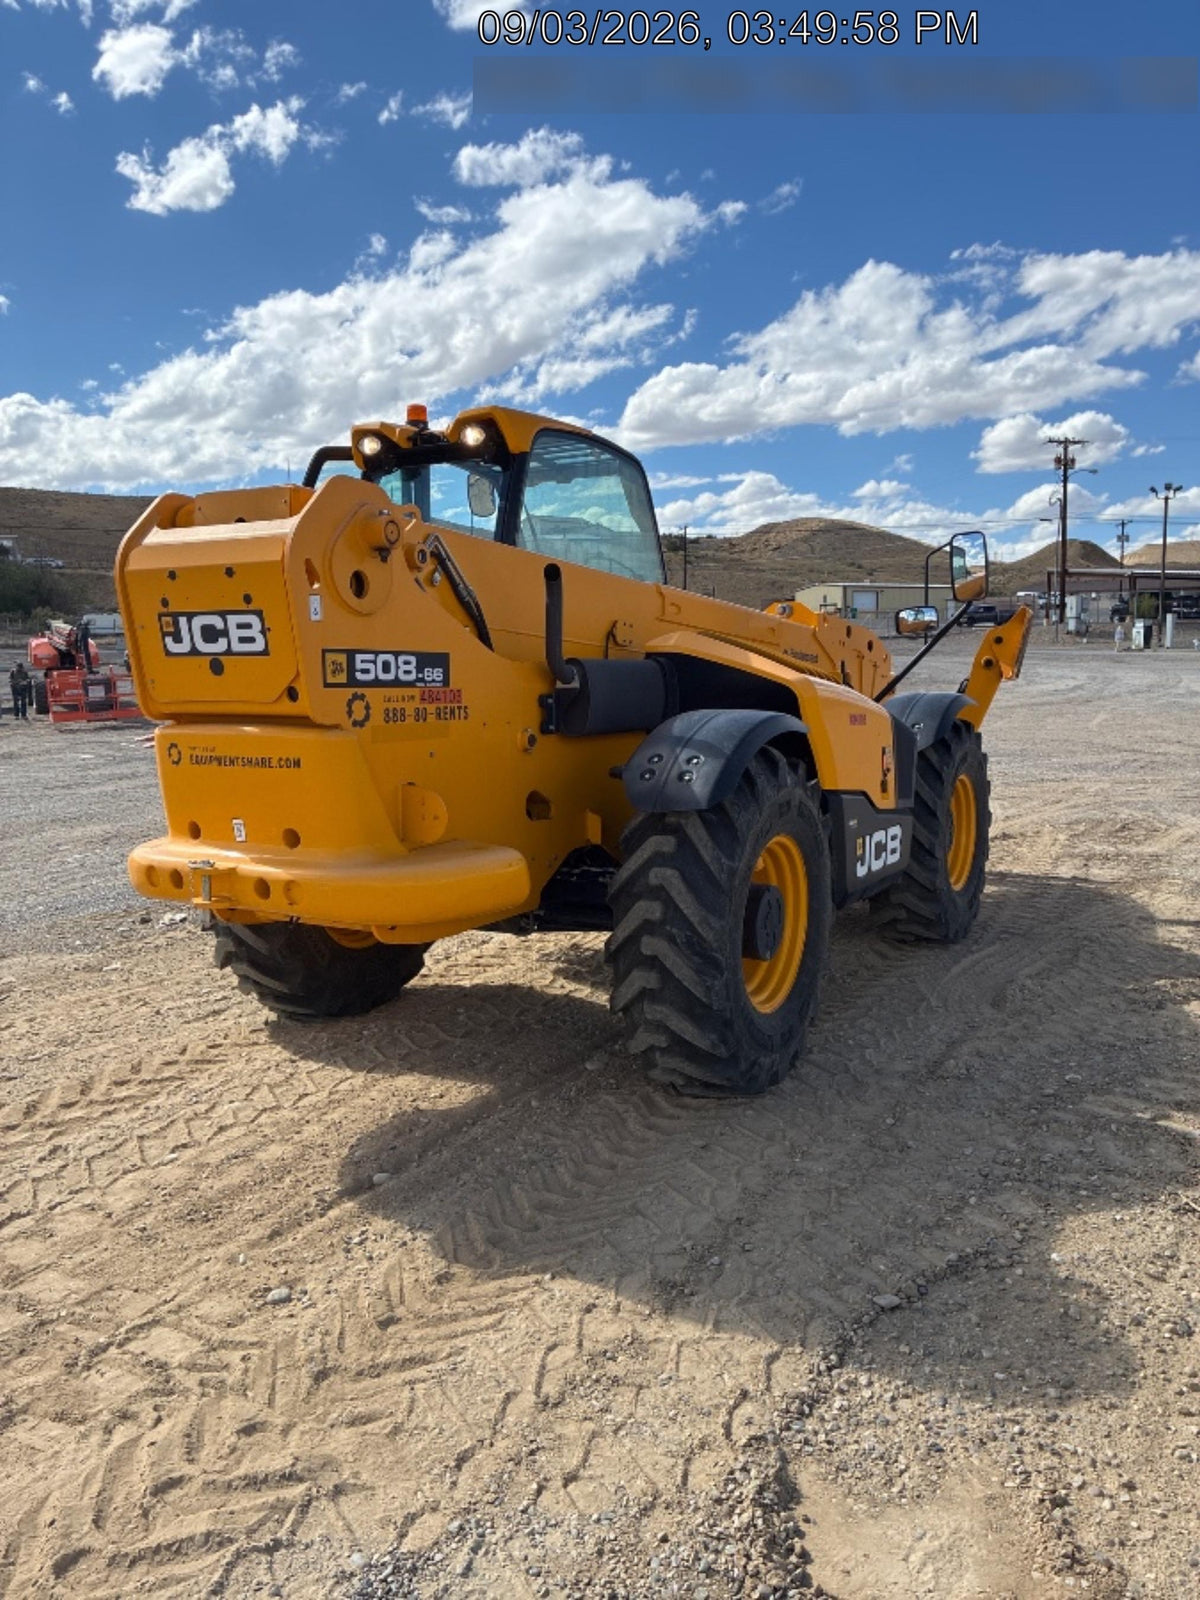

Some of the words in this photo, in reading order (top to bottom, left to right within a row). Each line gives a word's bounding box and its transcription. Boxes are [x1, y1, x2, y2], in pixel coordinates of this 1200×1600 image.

[164, 614, 265, 653] JCB
[354, 653, 443, 682] 508-66
[856, 825, 902, 877] JCB
